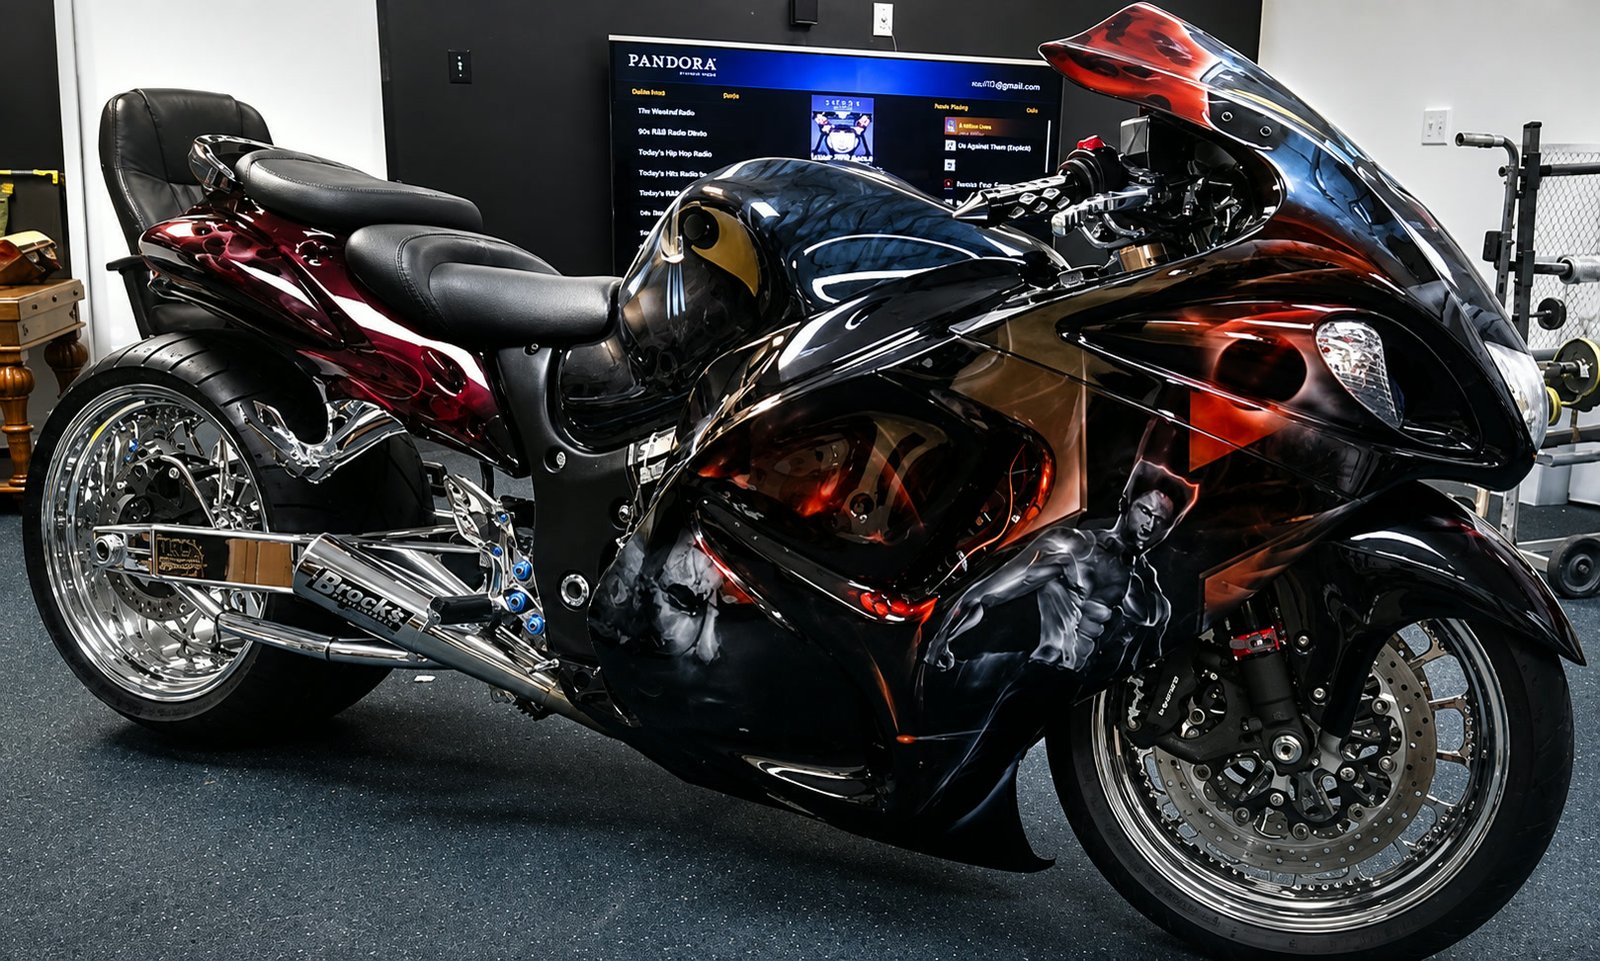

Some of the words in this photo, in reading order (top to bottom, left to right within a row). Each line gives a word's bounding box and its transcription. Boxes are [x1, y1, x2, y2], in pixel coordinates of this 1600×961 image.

[629, 53, 716, 71] PANDORA
[967, 142, 989, 151] Against
[639, 148, 664, 158] Today's
[666, 149, 677, 158] Hip
[679, 149, 692, 158] Hop
[694, 150, 712, 158] Radio
[639, 169, 664, 179] Today's
[680, 170, 698, 178] Radio
[639, 189, 664, 198] Today's
